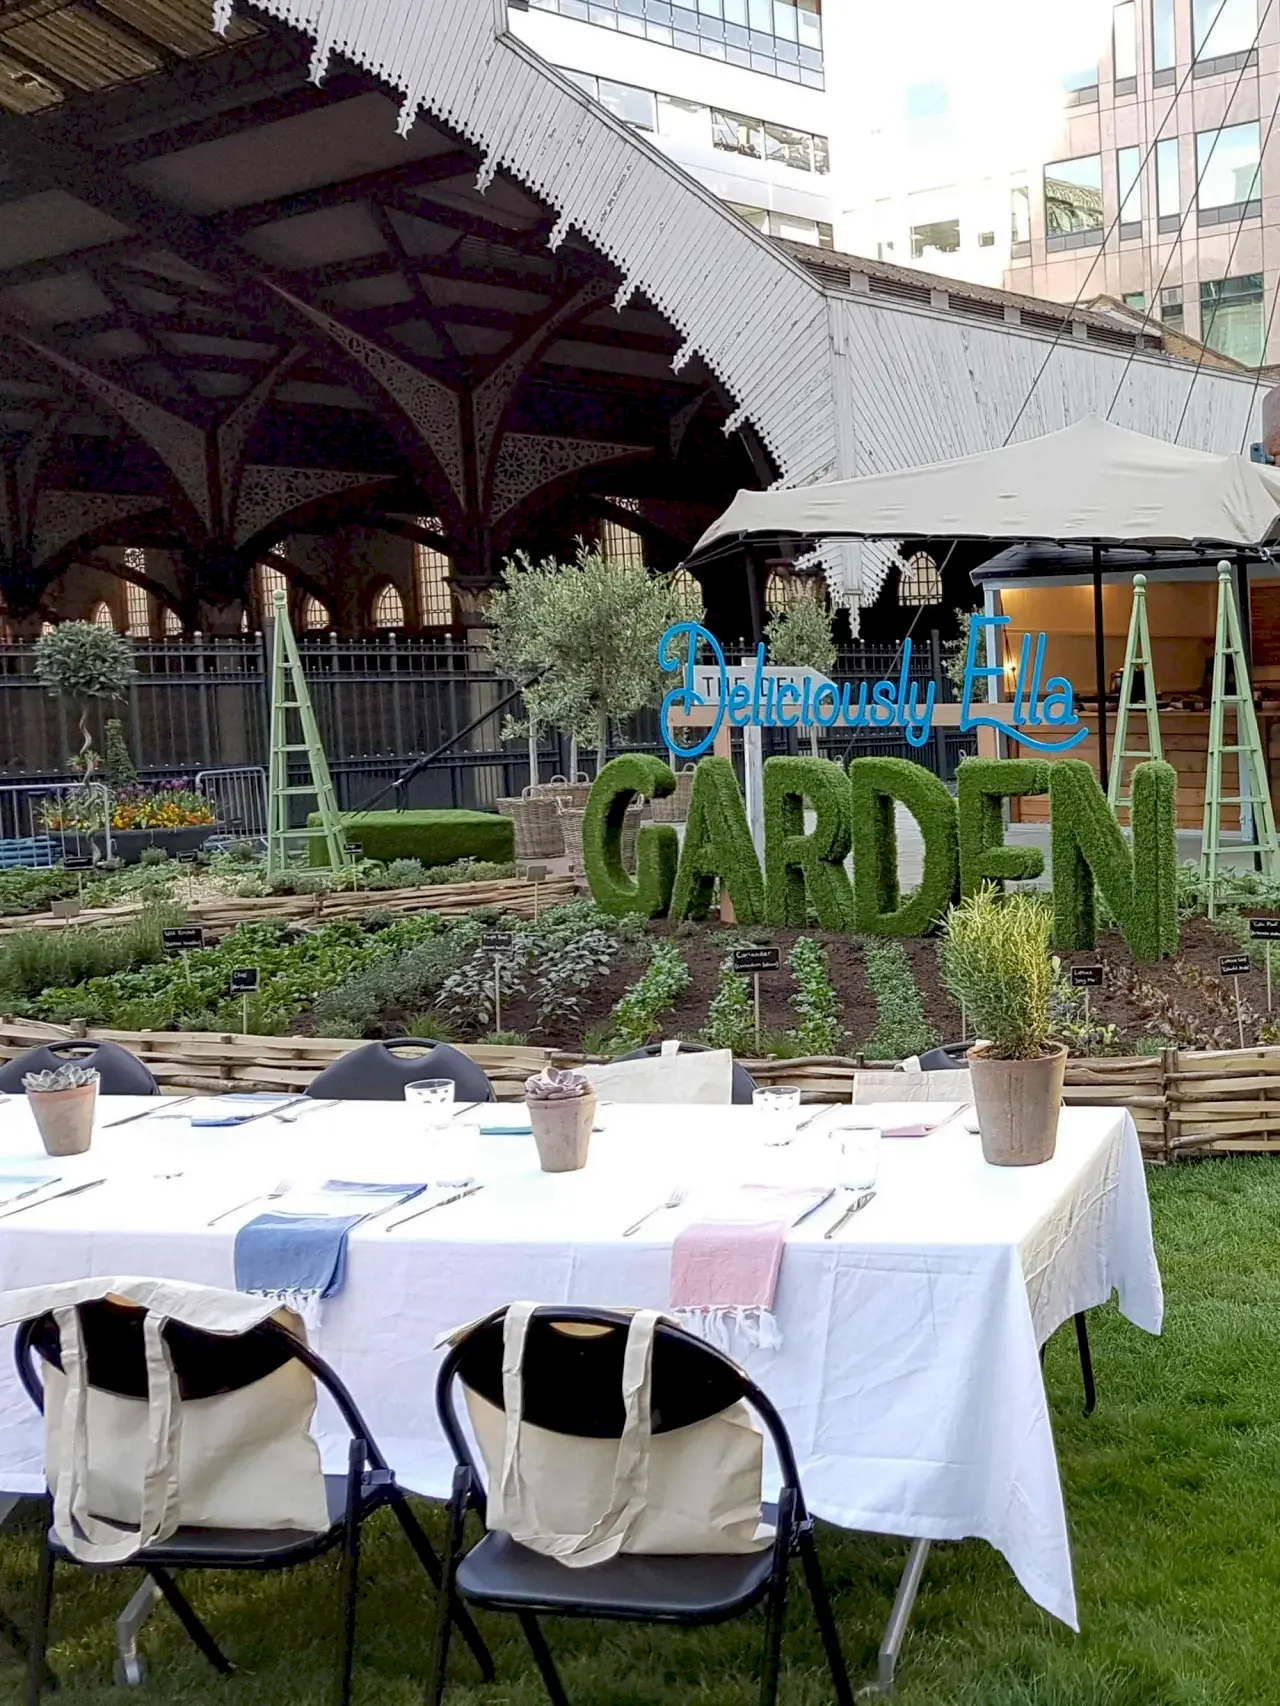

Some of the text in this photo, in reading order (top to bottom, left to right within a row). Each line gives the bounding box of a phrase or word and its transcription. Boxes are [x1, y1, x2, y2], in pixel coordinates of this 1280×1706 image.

[658, 613, 1089, 758] Deliciously Ella
[702, 676, 746, 698] THE
[582, 752, 1180, 962] GARDEN
